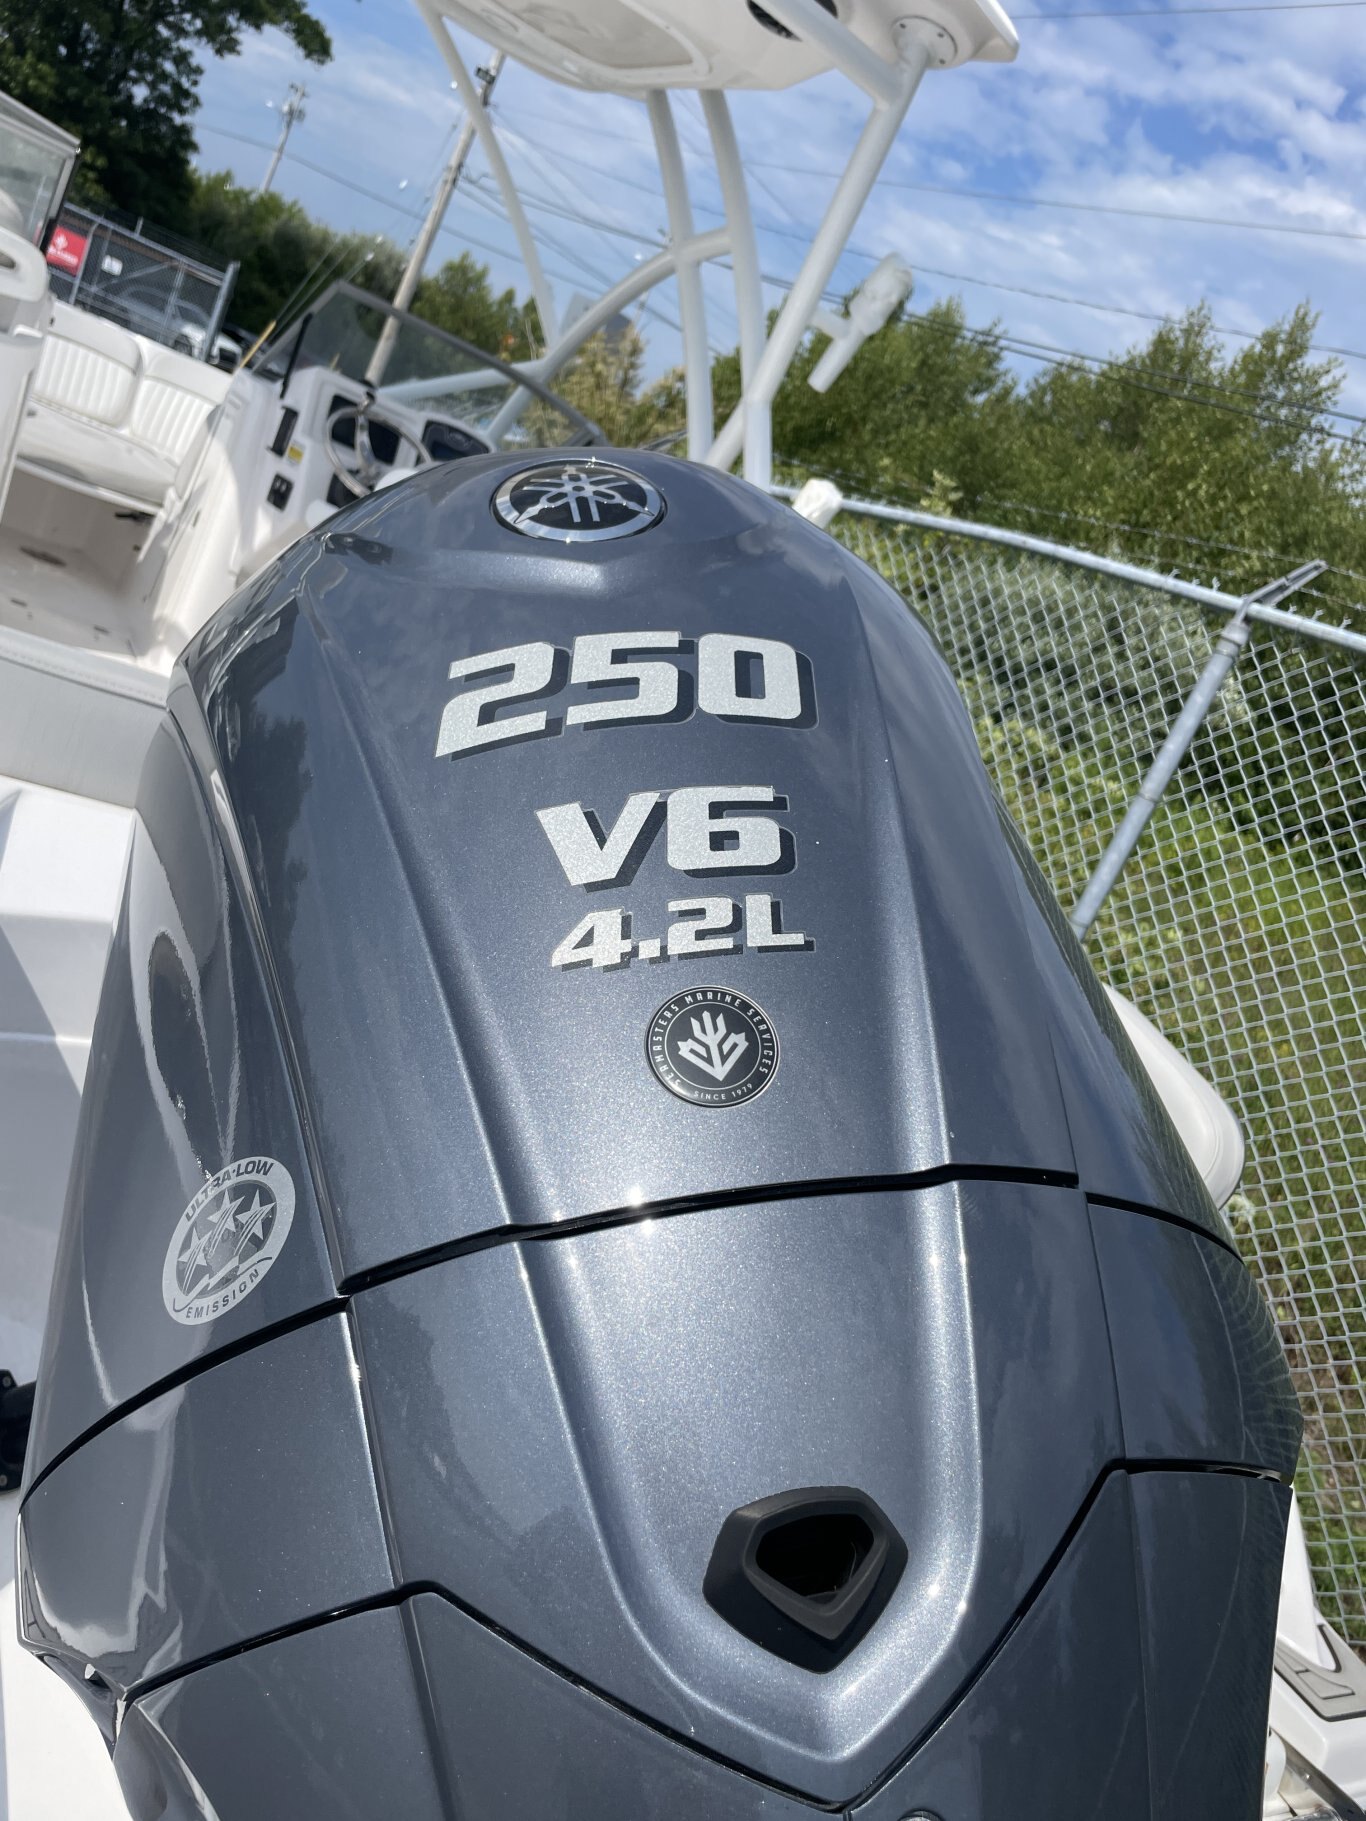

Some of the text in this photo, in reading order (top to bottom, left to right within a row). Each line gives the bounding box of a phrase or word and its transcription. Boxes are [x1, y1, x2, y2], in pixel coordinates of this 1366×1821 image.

[435, 631, 819, 762] 250
[535, 785, 798, 893] V6
[551, 893, 816, 972] 4.2L
[652, 991, 773, 1087] SEAMASTERS MARINE SERVICES
[693, 1082, 753, 1101] SINCE 1979
[185, 1268, 259, 1319] EMISSION
